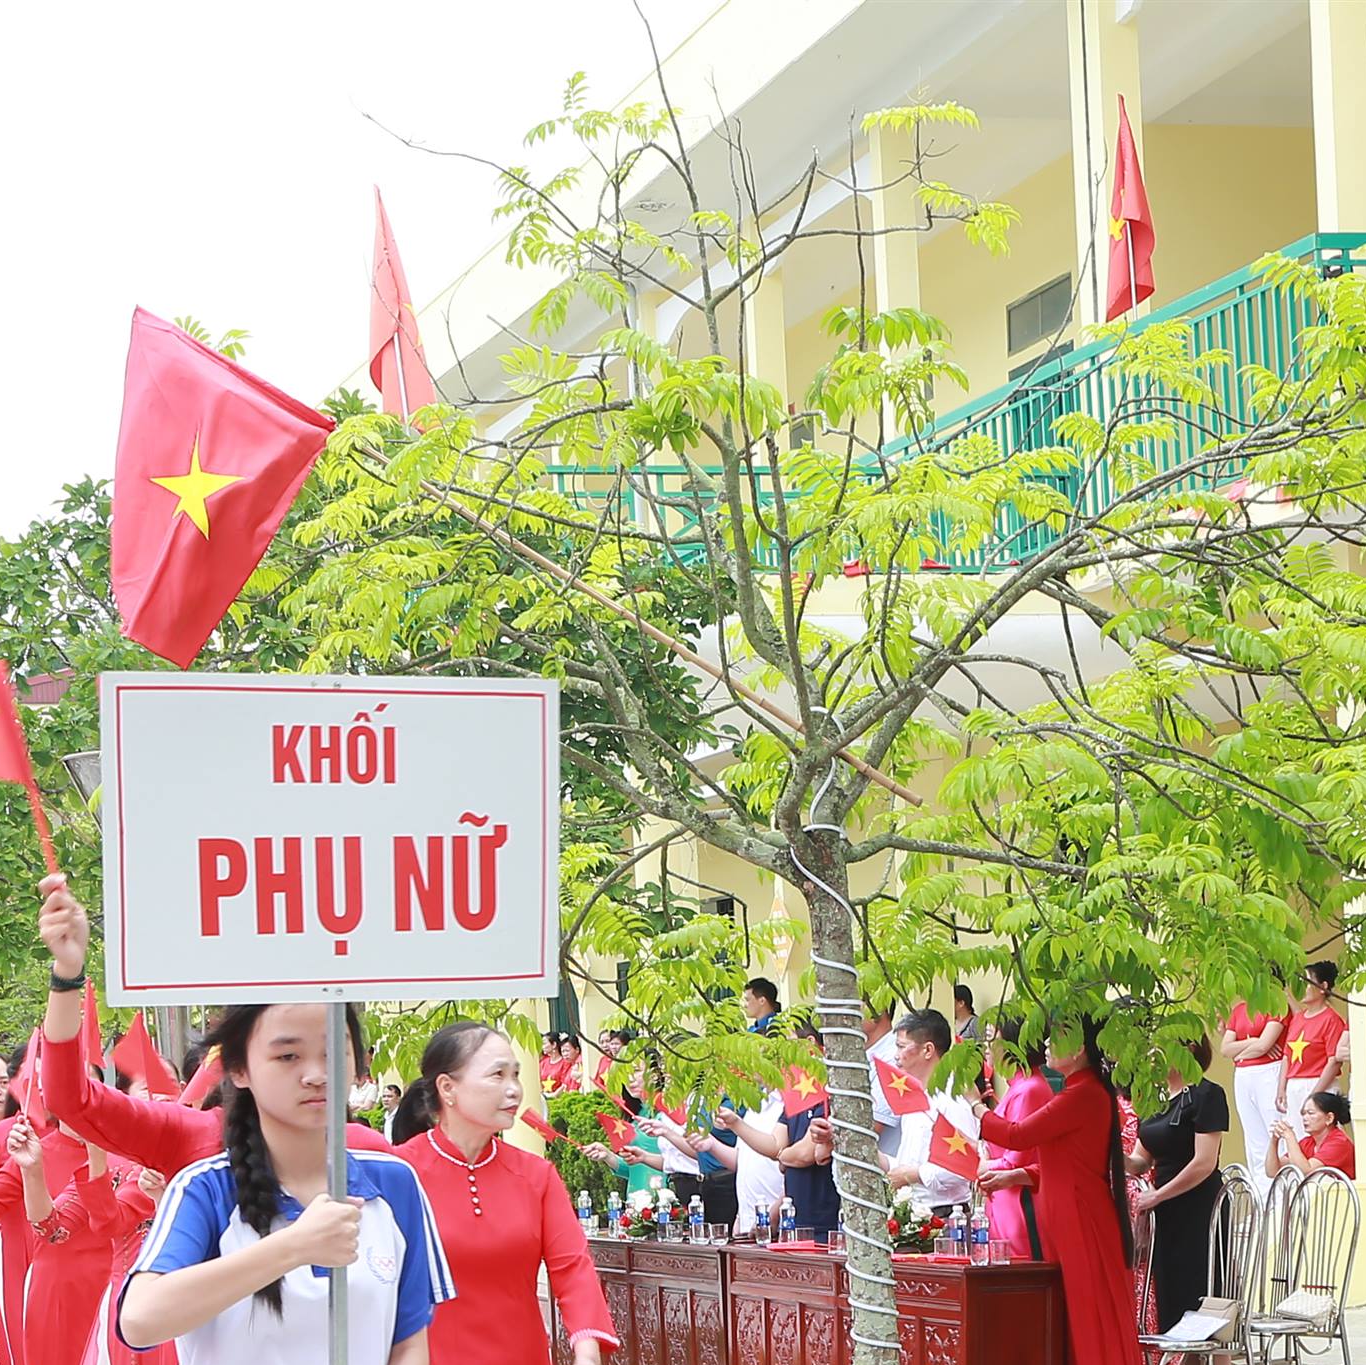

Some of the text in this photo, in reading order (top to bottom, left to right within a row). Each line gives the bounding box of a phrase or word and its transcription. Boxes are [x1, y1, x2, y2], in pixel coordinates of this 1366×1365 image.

[271, 702, 397, 784] KHỐI
[197, 810, 509, 956] PHỤ NỮ
